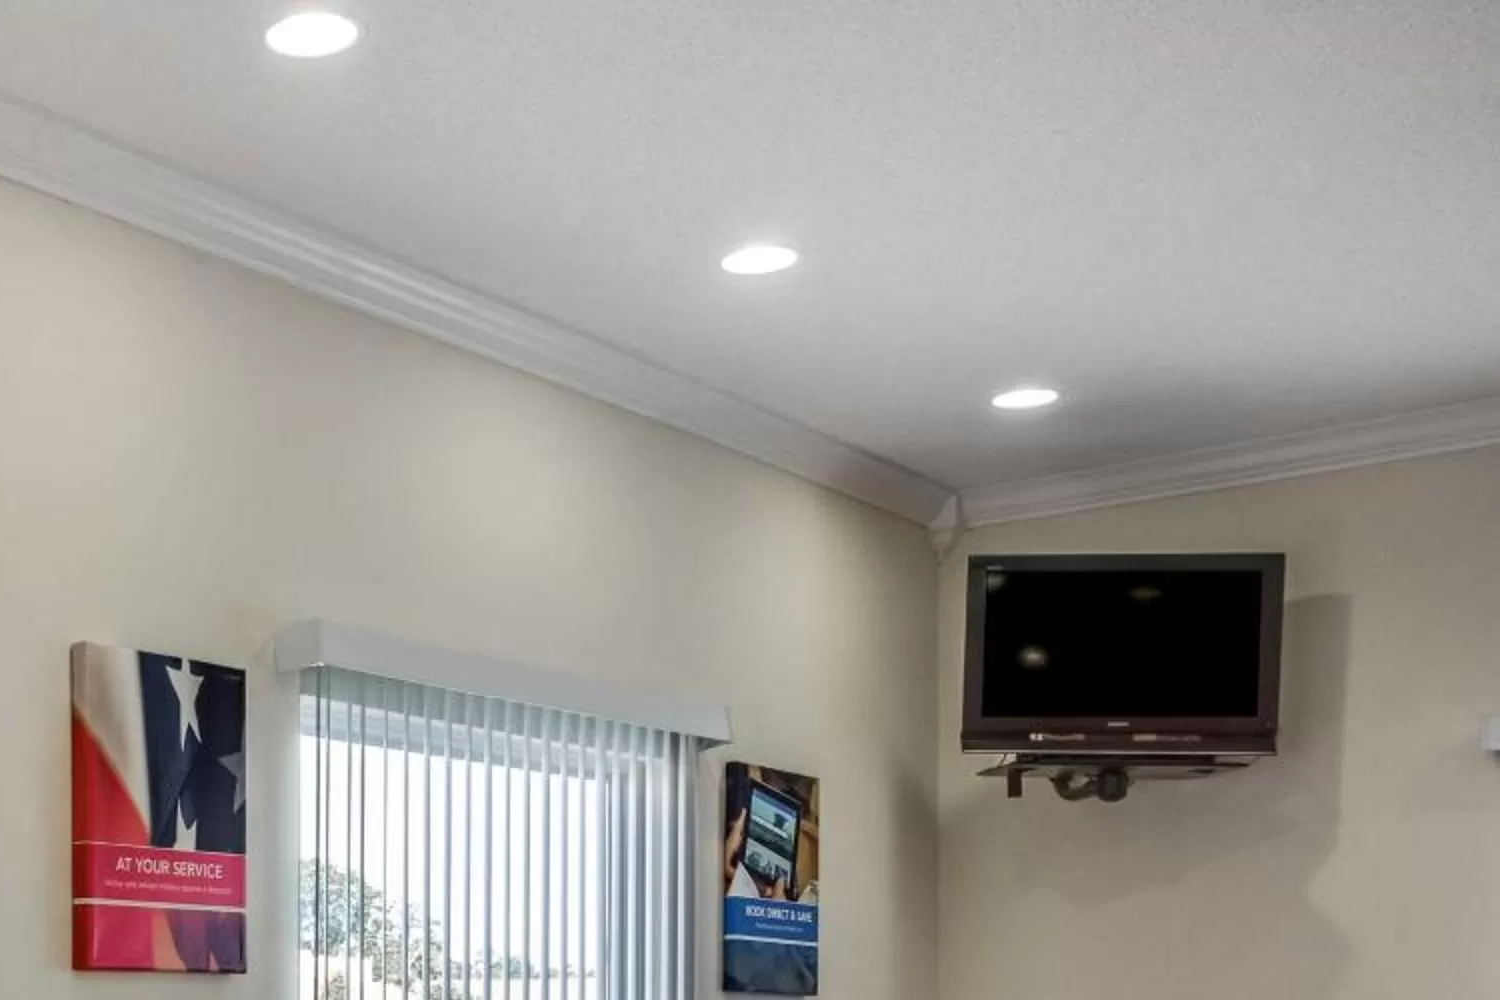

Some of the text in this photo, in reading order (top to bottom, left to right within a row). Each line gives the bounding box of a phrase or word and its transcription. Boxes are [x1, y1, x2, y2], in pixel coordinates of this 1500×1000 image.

[116, 856, 224, 879] AT YOUR SERVICE
